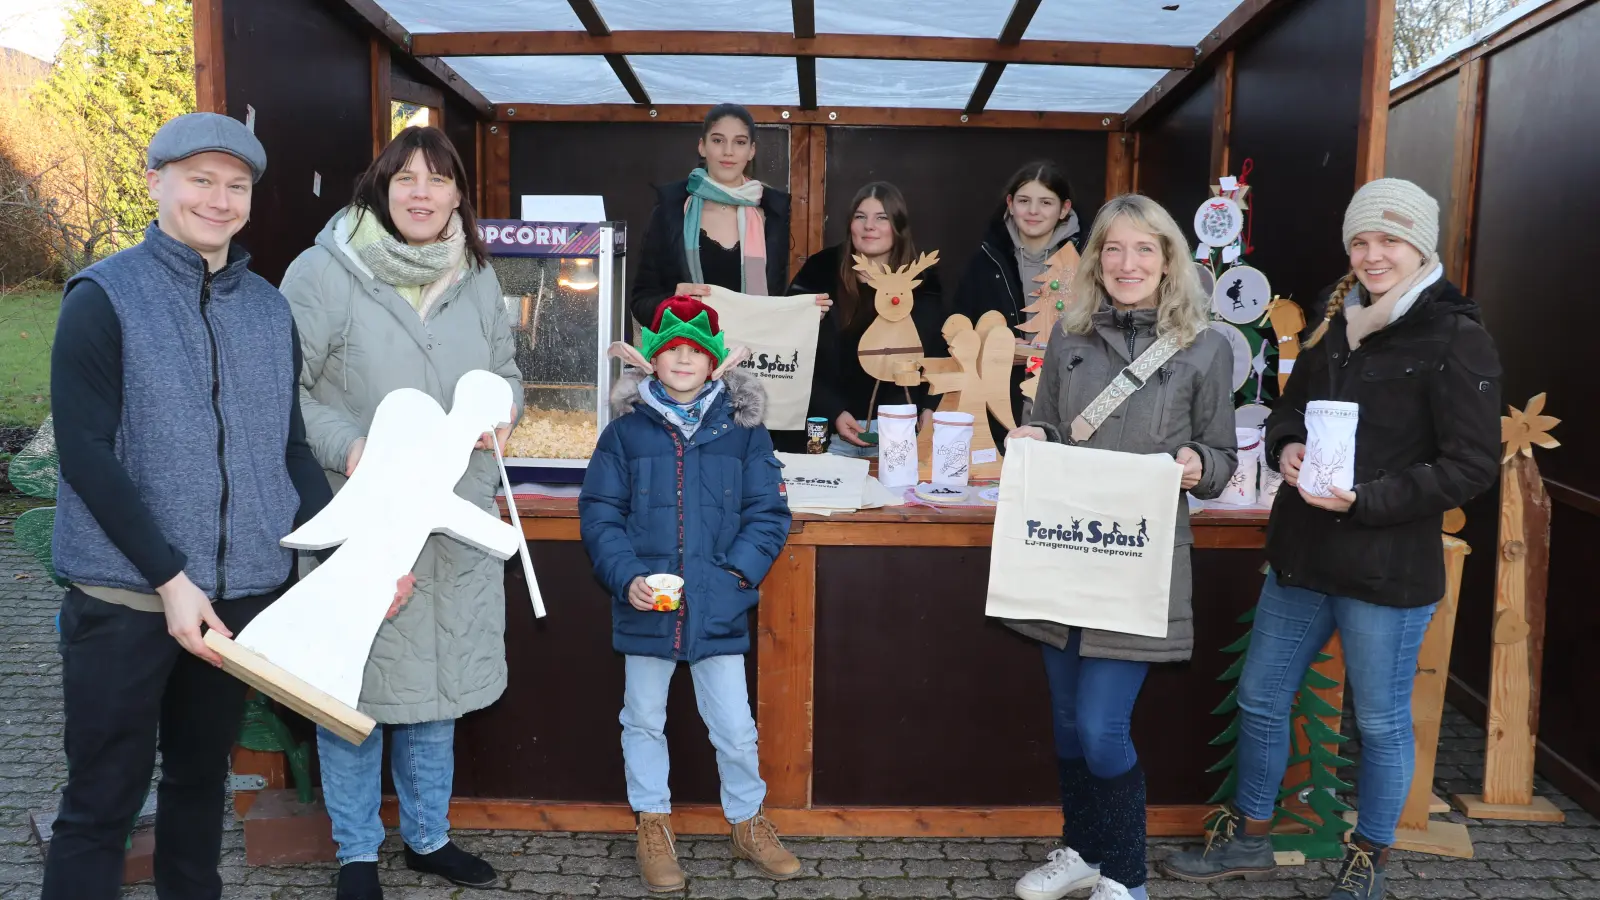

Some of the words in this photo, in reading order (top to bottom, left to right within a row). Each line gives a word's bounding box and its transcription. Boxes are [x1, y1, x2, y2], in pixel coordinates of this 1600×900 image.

[477, 226, 568, 245] PCORN
[756, 353, 795, 374] Spass
[1026, 520, 1083, 542] Ferien
[1086, 521, 1144, 548] Spass
[1092, 547, 1143, 557] Seeprovinz
